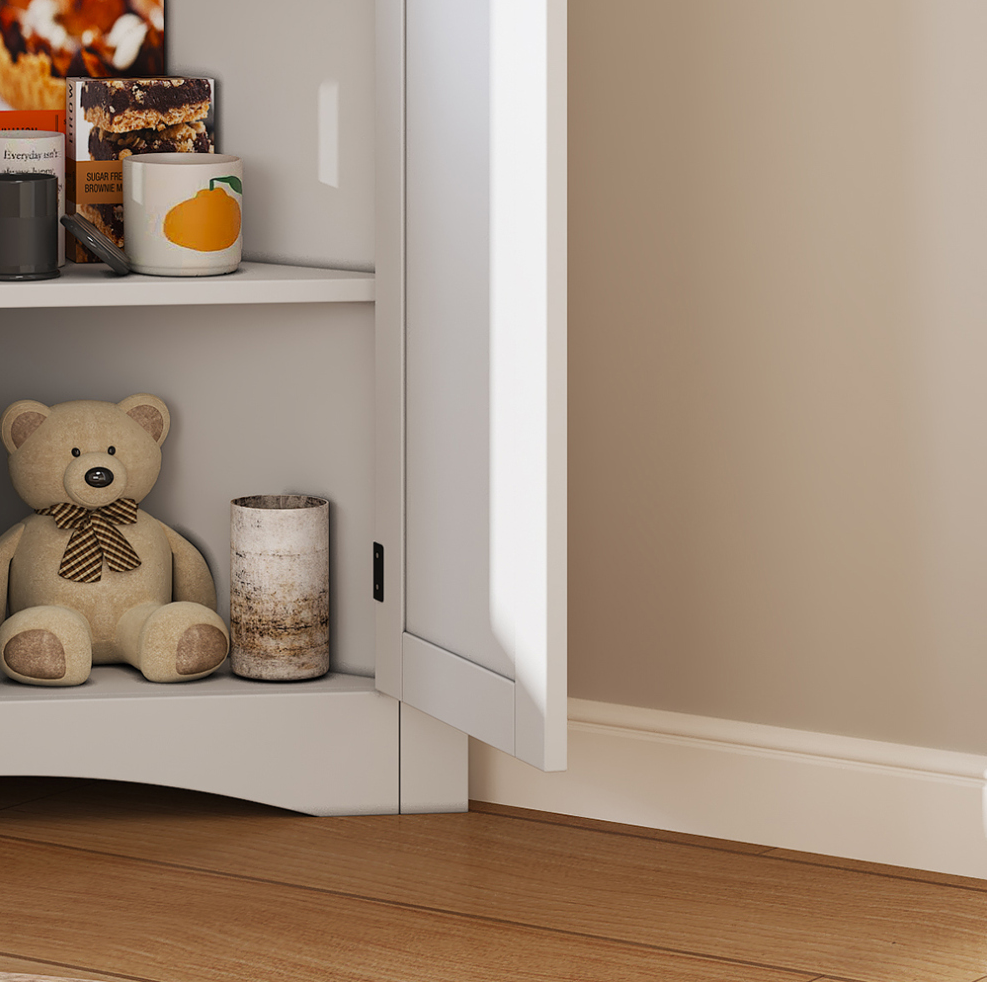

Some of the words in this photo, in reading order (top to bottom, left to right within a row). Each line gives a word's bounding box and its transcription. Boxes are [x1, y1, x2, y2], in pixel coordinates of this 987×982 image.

[3, 149, 42, 161] Everyday
[86, 172, 109, 182] SUGAR
[85, 183, 115, 193] BROWNIE
